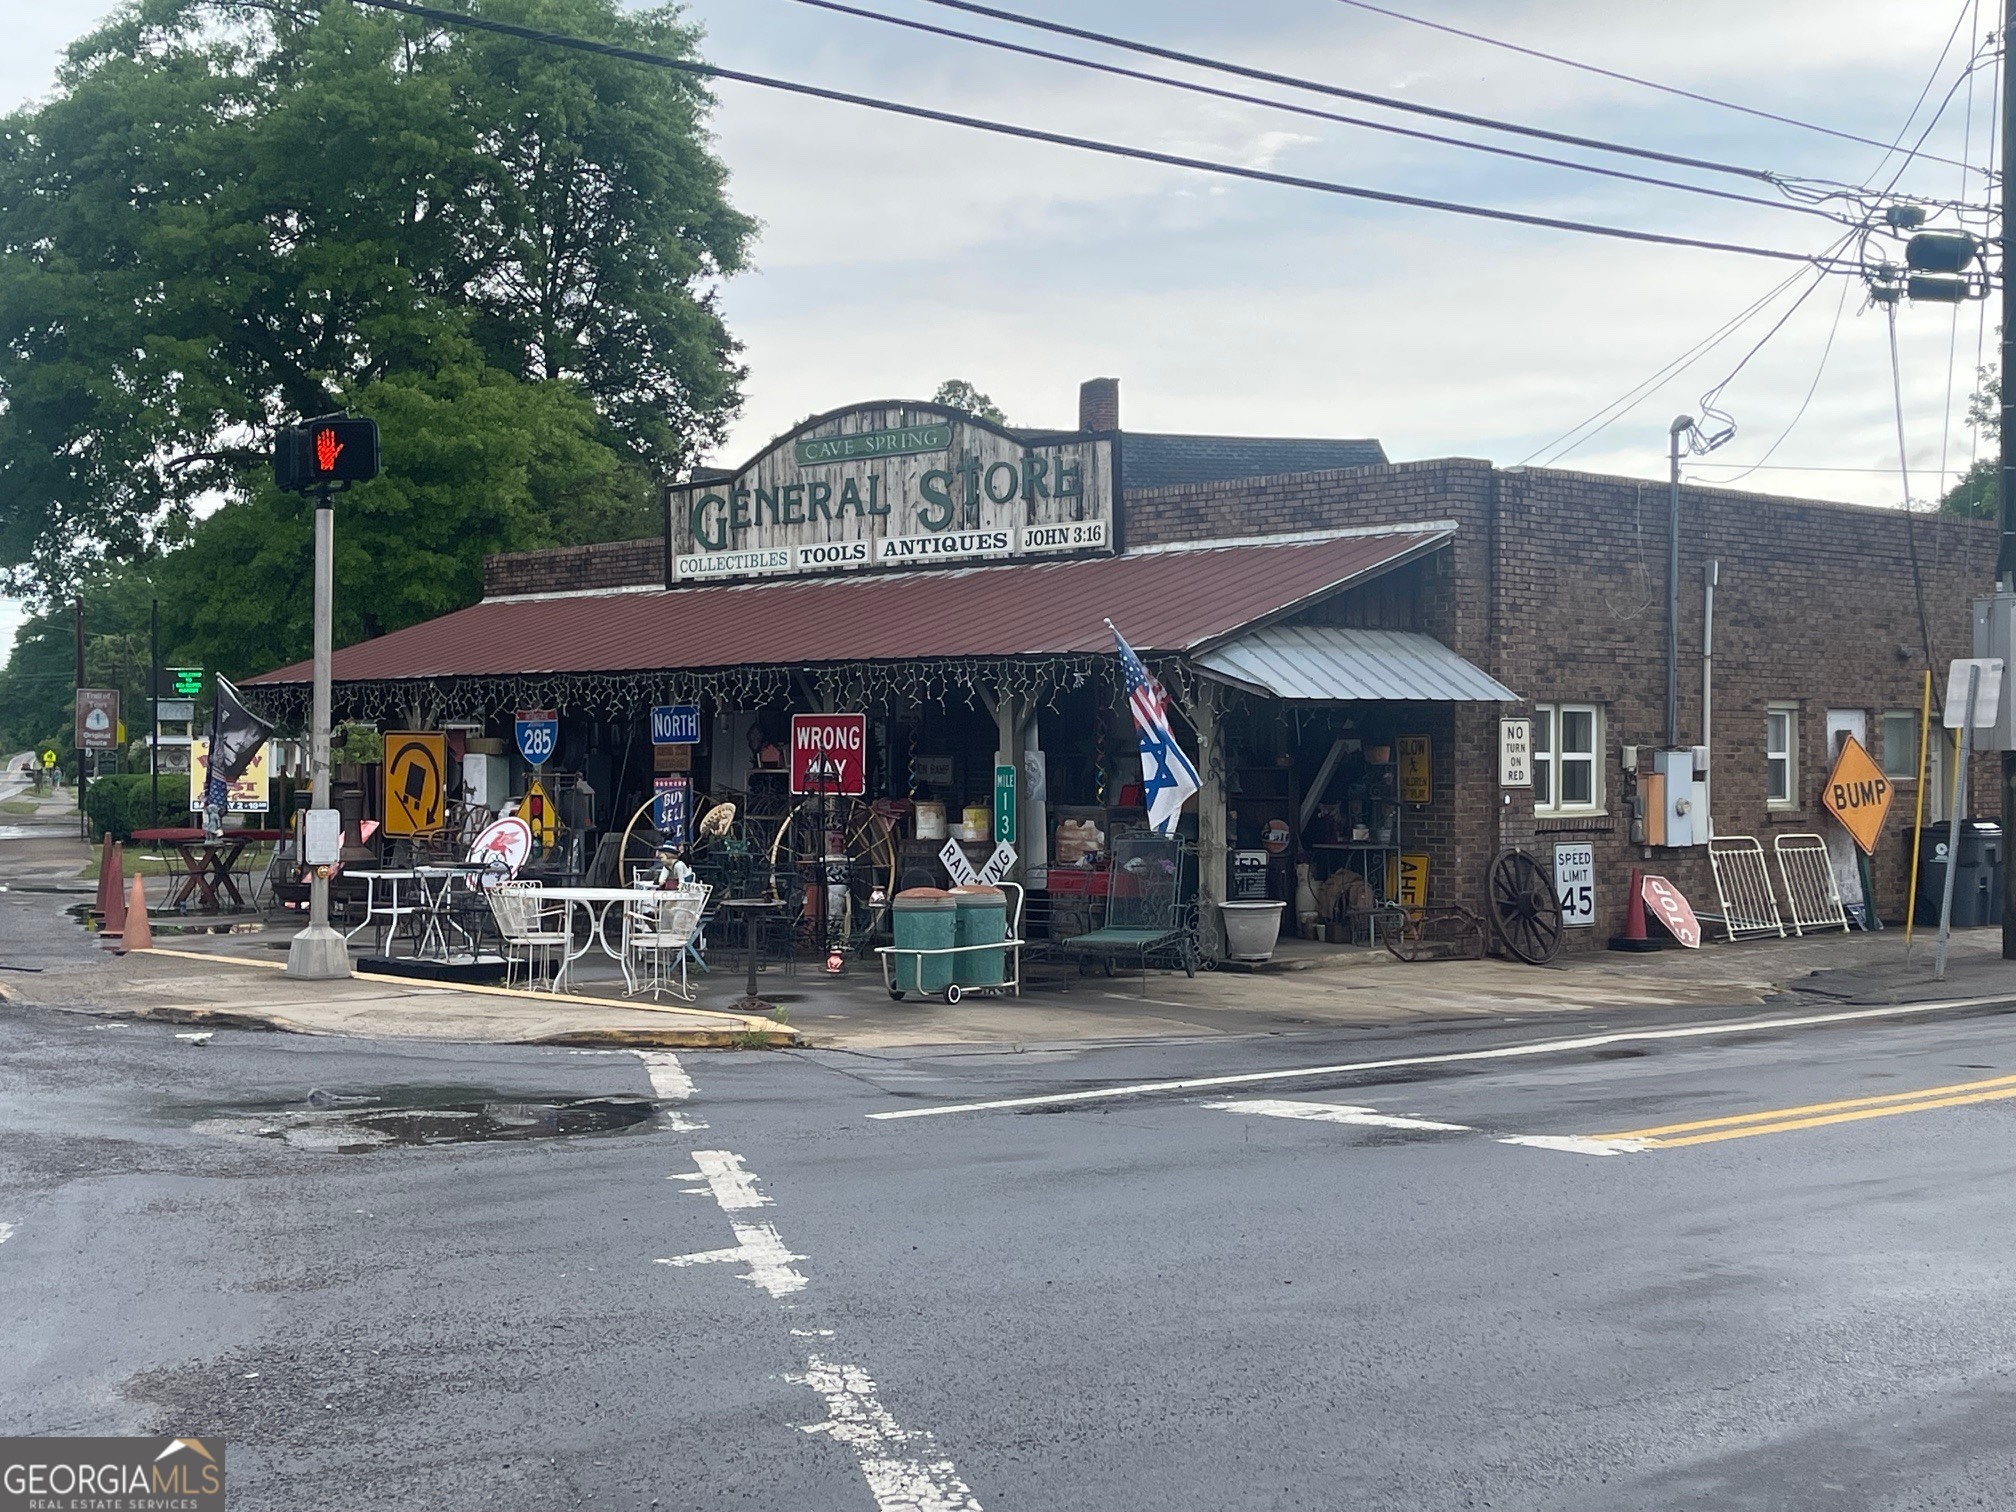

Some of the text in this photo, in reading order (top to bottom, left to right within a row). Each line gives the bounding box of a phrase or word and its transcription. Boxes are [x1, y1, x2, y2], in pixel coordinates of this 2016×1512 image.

[805, 429, 939, 460] CAVE SPRING
[693, 455, 1081, 551] GENERAL STORE
[883, 532, 1008, 557] ANTIQUES
[1024, 525, 1102, 547] JOHN 3:16
[679, 552, 789, 574] COLLECTIBLES
[800, 544, 866, 564] TOOLS
[83, 731, 111, 739] Original
[654, 713, 697, 738] NORTH
[1507, 725, 1524, 740] NO
[524, 728, 552, 755] 285
[796, 725, 861, 751] WRONG
[1399, 739, 1425, 756] SLOW
[1506, 742, 1526, 753] TURN
[1510, 756, 1522, 767] ON
[997, 774, 1014, 788] MILE
[1508, 770, 1525, 781] RED
[663, 791, 684, 807] BUY
[1833, 779, 1886, 810] BUMP
[1558, 852, 1591, 866] SPEED
[1562, 869, 1588, 883] LIMIT
[1561, 886, 1592, 916] 45
[1651, 880, 1694, 943] STOP
